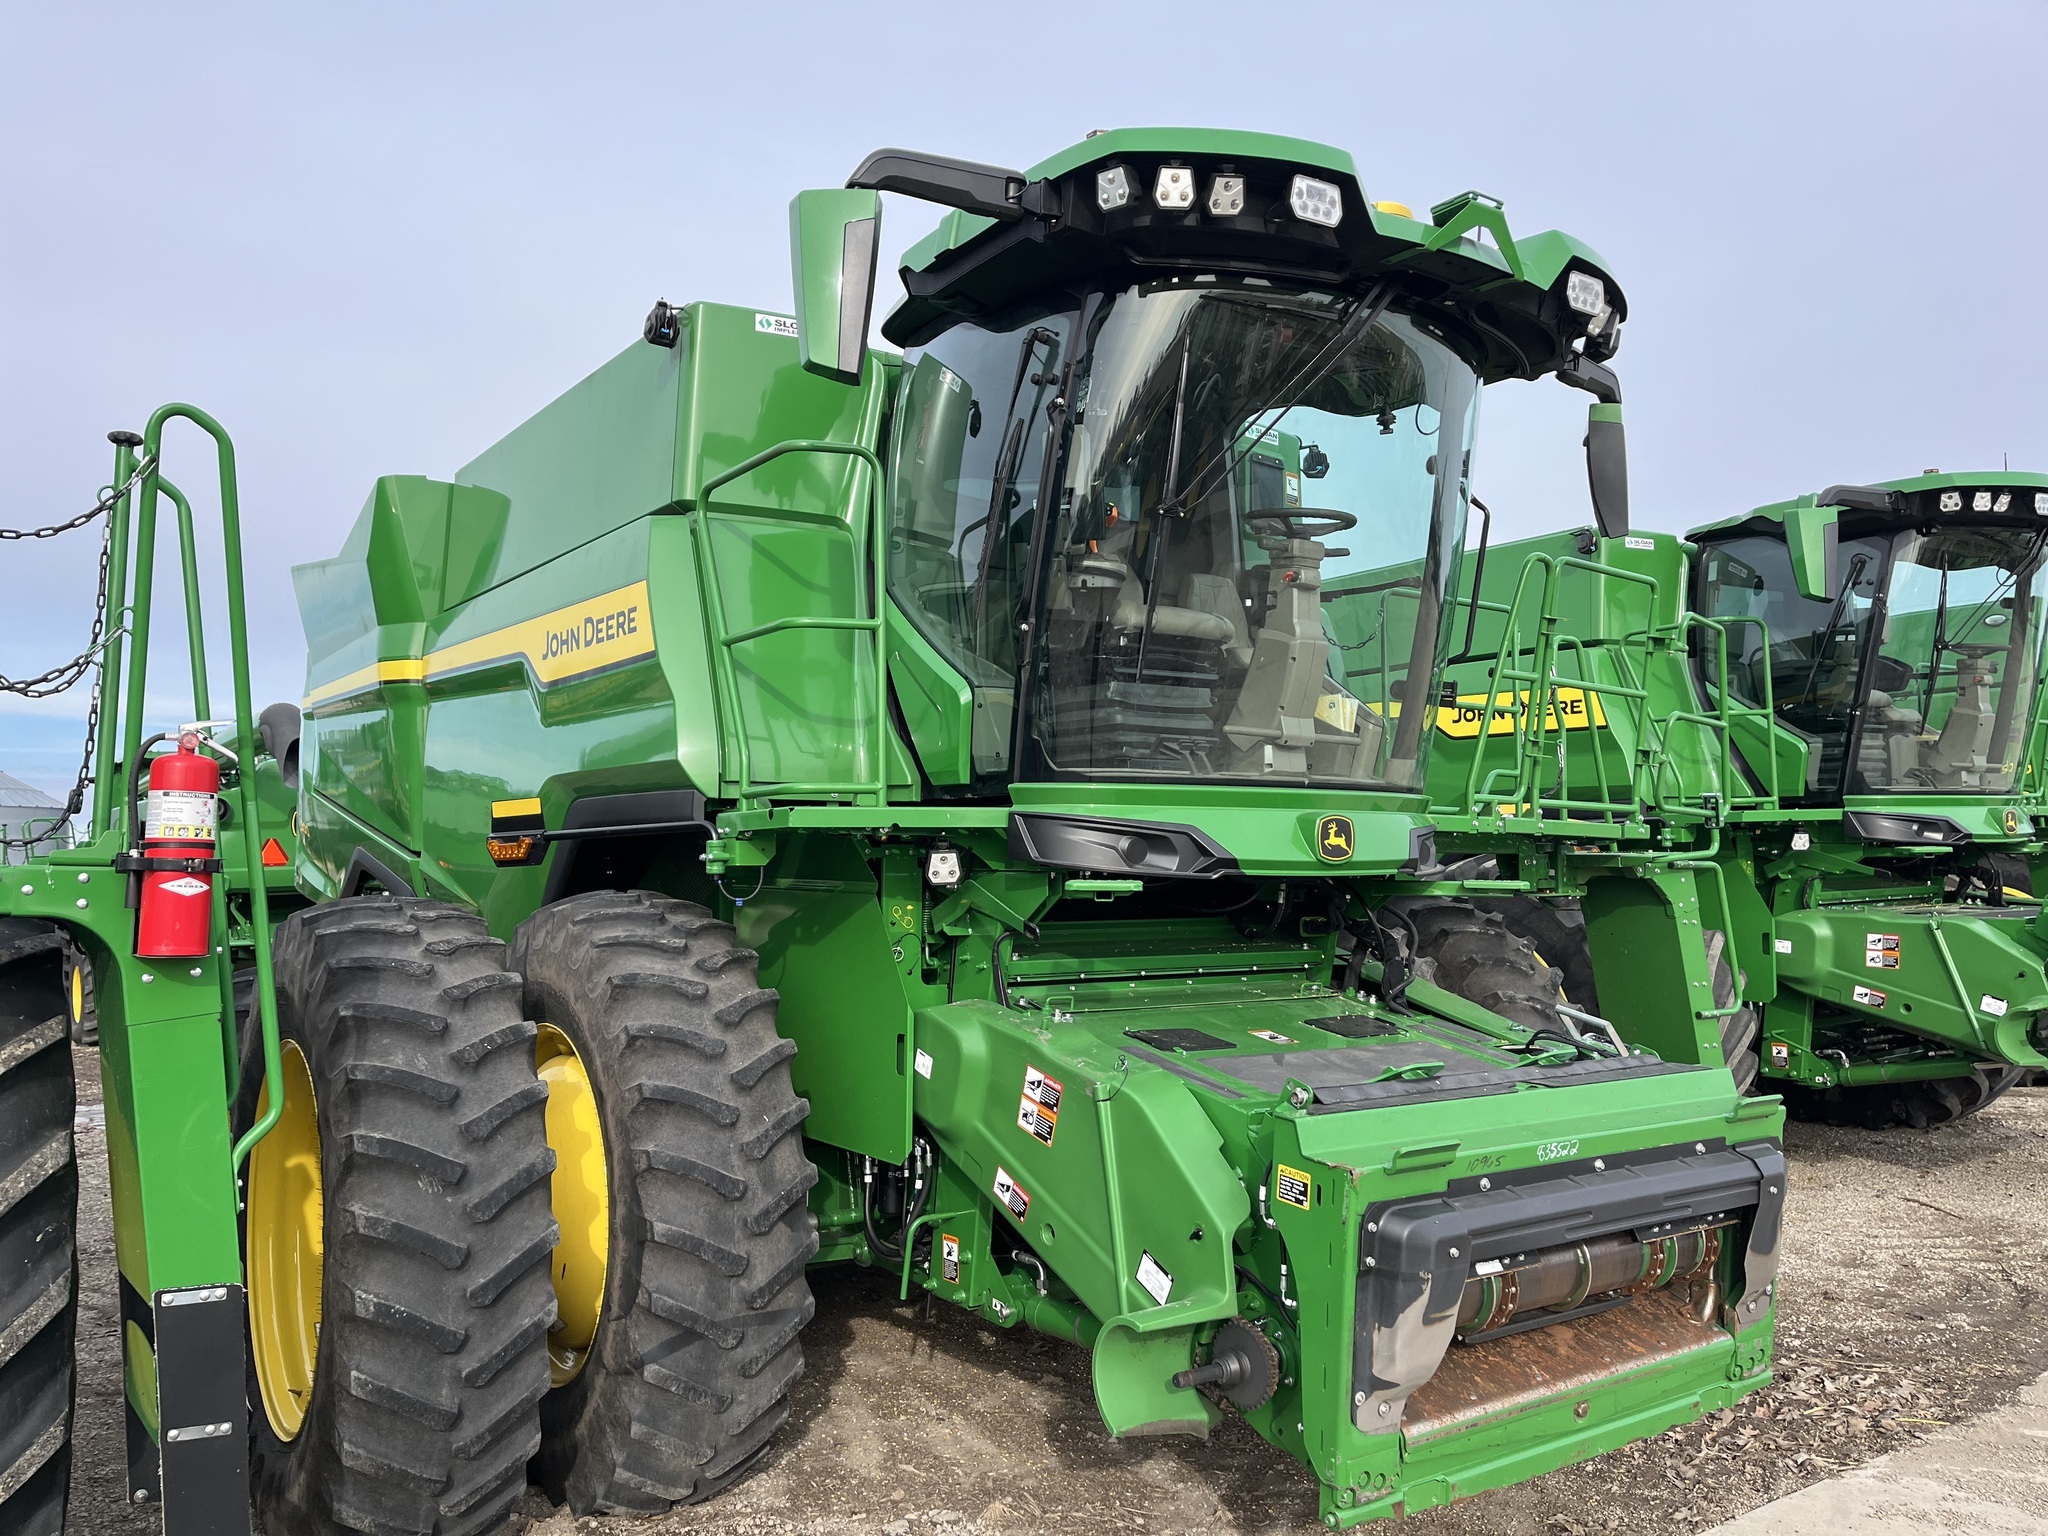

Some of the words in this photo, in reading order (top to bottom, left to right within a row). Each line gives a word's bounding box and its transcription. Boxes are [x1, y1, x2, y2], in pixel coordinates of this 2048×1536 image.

[542, 625, 580, 661] JOHN
[584, 605, 638, 648] DEERE
[168, 791, 211, 799] INSTRUCTIONS
[1537, 1139, 1580, 1162] 835522
[1465, 1155, 1507, 1174] 10965
[1284, 1168, 1310, 1182] CAUTION
